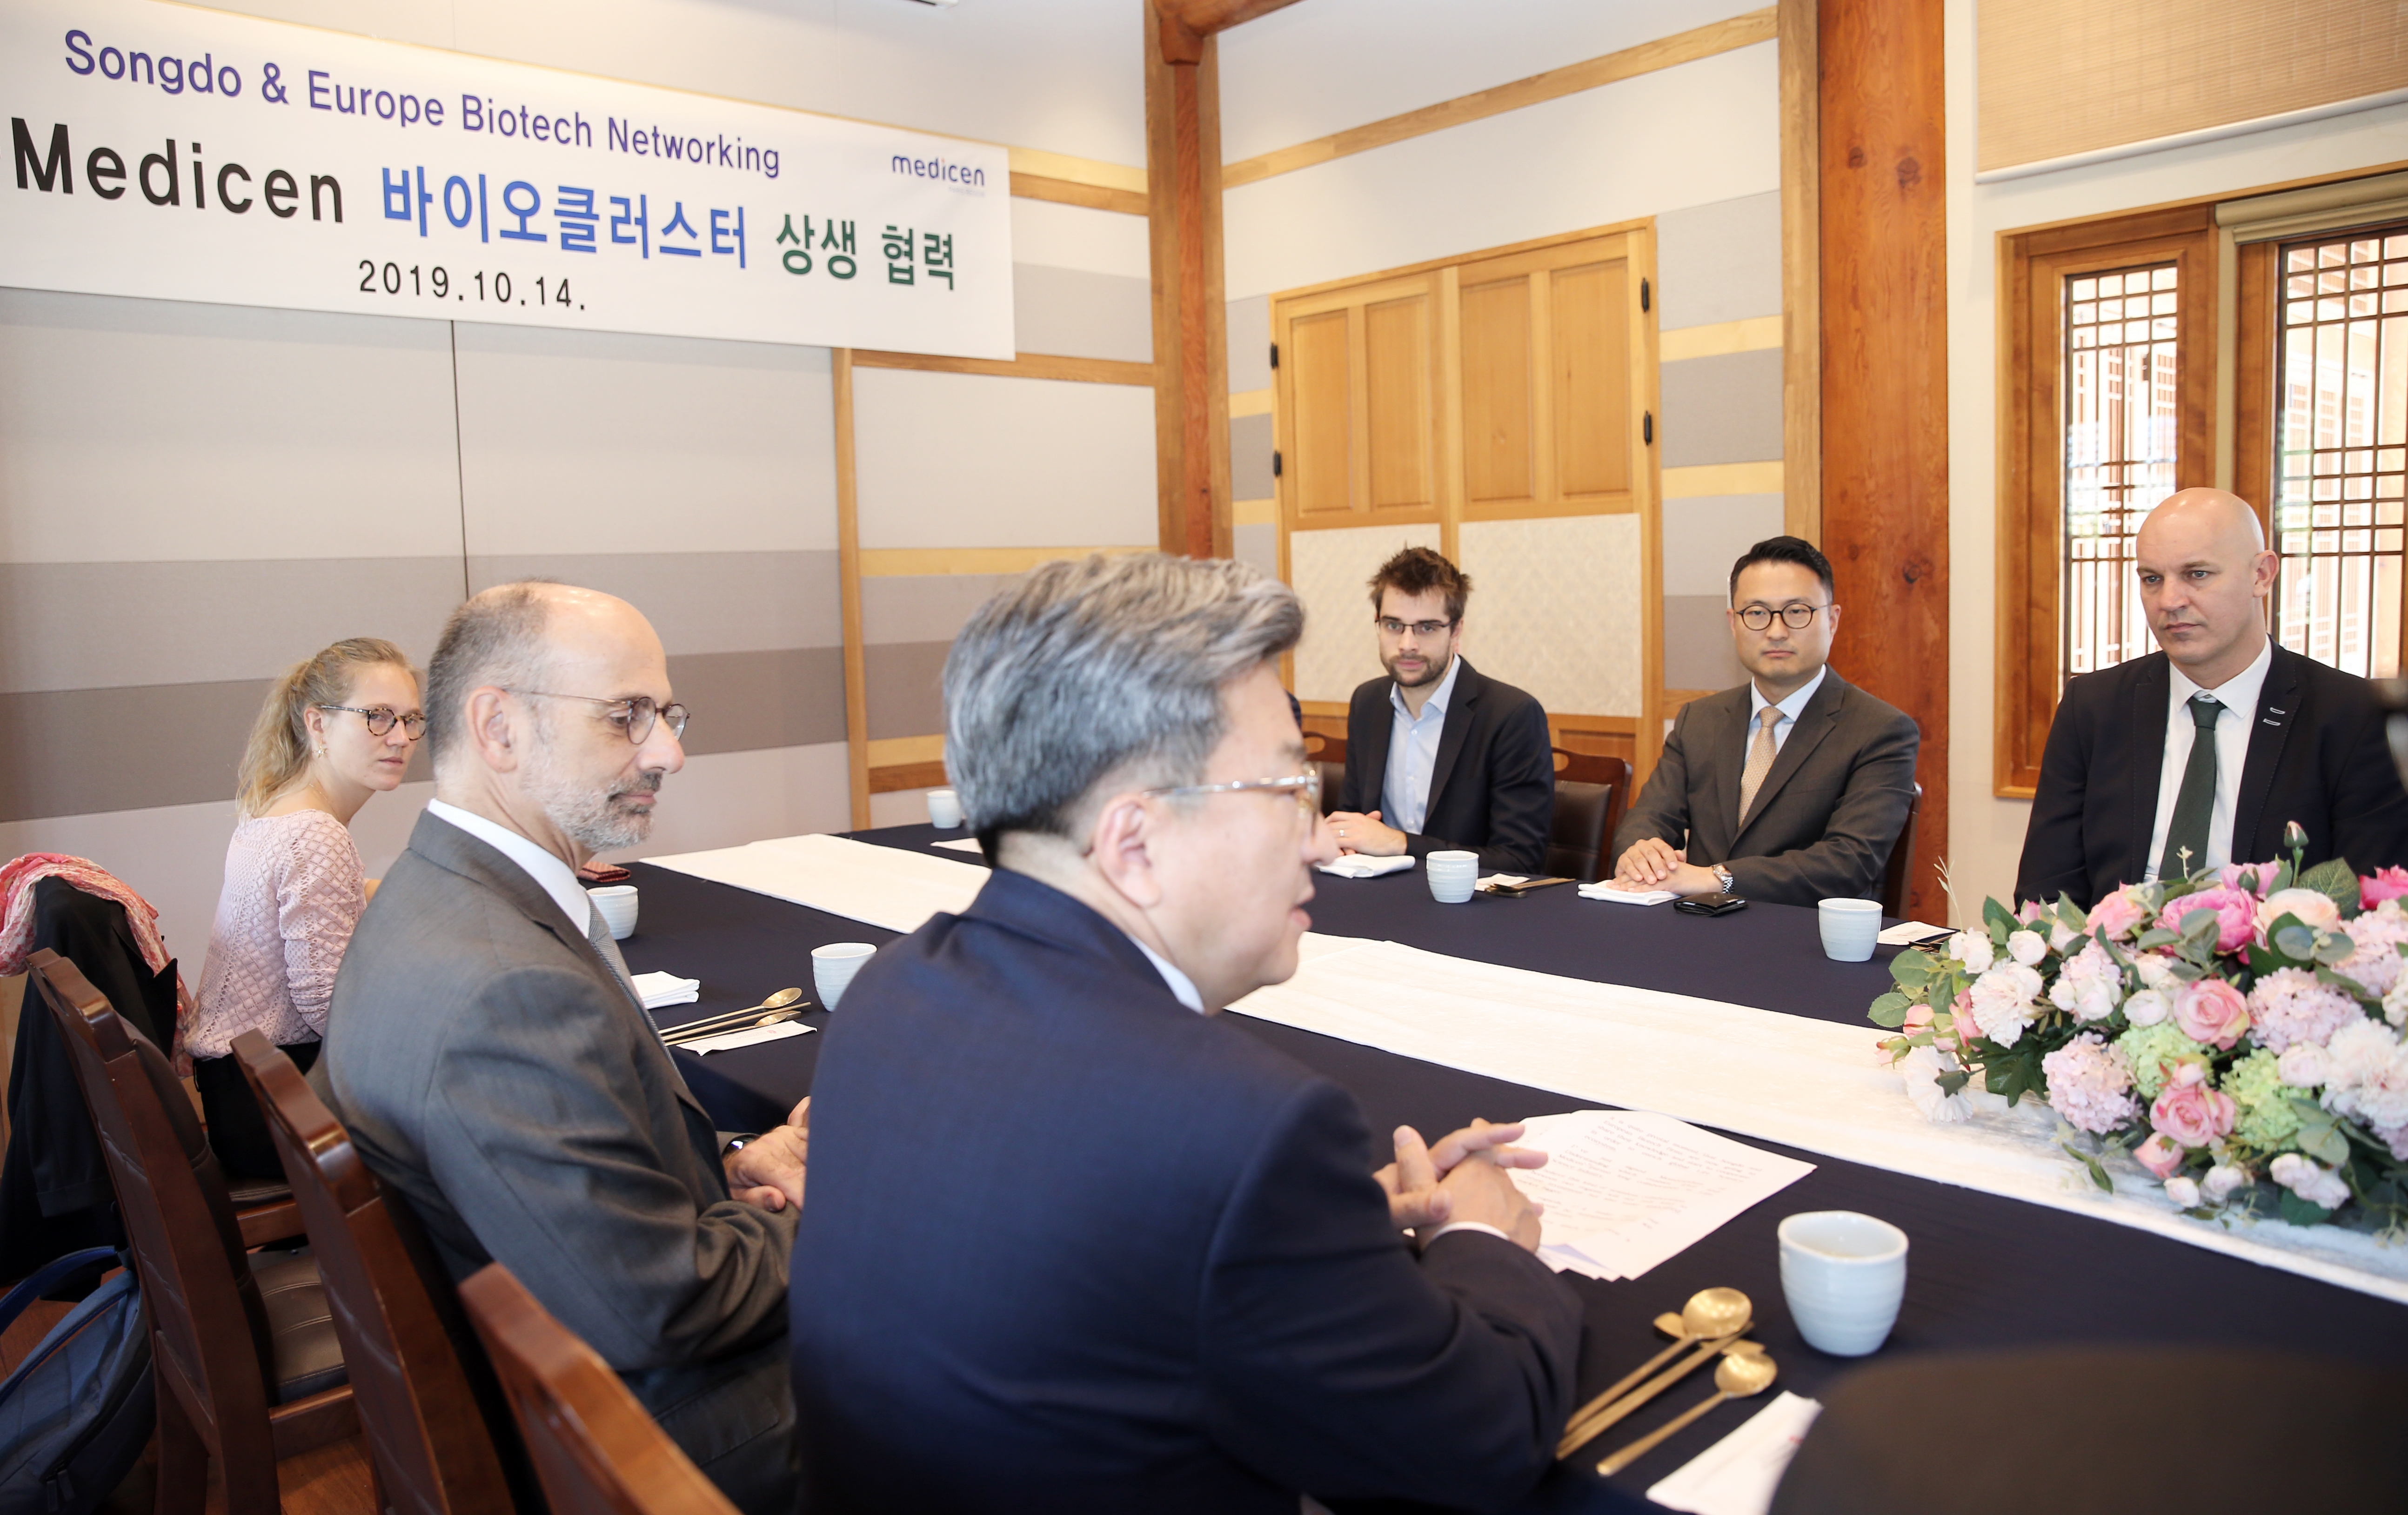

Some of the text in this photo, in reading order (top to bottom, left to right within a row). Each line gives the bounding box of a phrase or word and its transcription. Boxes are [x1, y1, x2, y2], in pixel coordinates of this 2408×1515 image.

[65, 29, 779, 179] Songdo & Europe Biotech Networking
[11, 116, 954, 291] Medicen 바이오클러스터 상생 협력
[892, 156, 984, 186] medicen
[359, 260, 585, 310] 2019.10.14.
